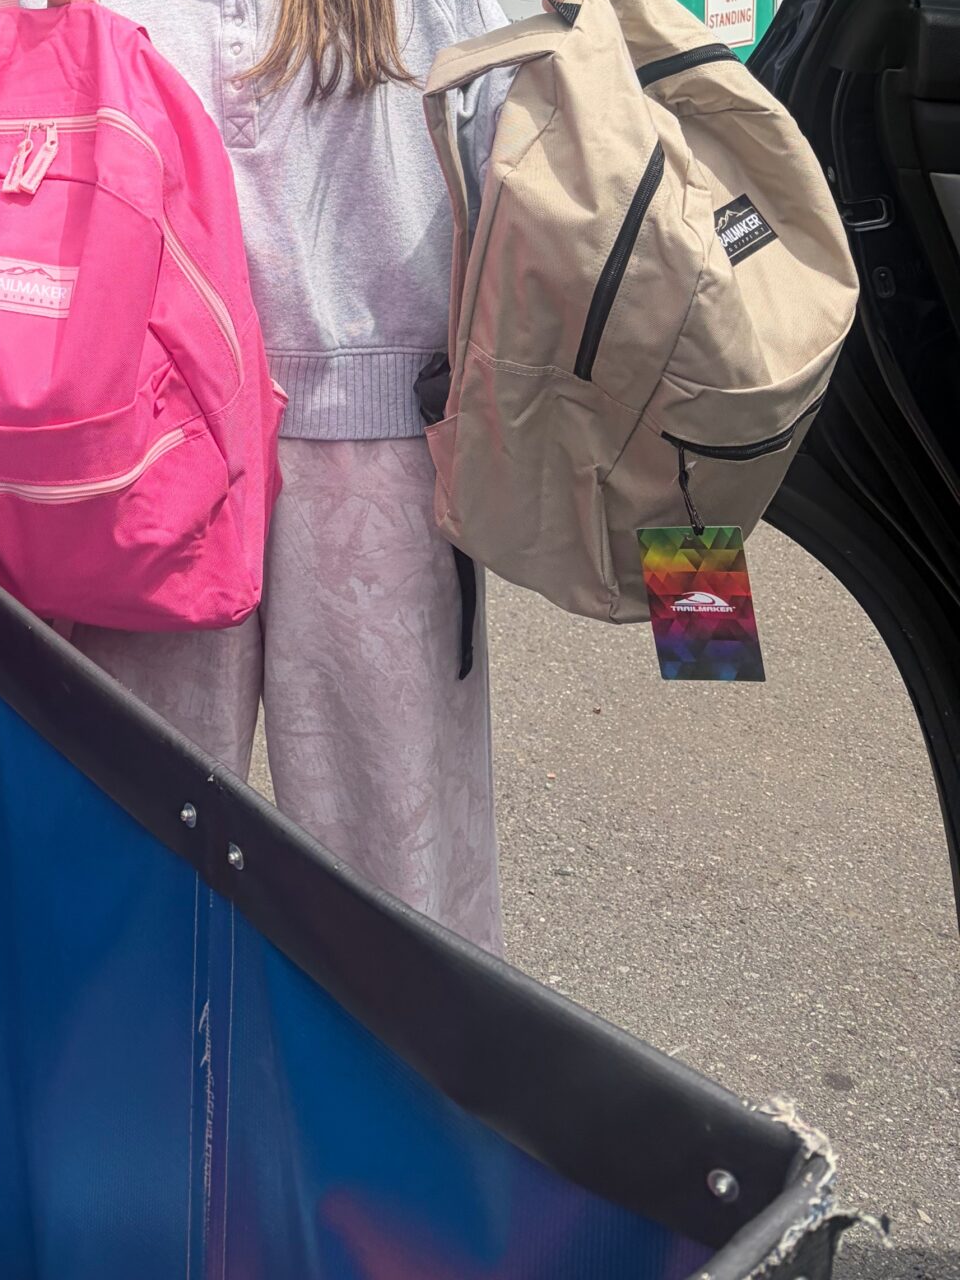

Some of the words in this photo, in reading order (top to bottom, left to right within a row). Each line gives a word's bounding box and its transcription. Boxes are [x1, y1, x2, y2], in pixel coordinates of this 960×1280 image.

[709, 8, 752, 29] STANDING
[719, 213, 762, 248] AILMAKER
[670, 605, 733, 613] TRAILMAKER
